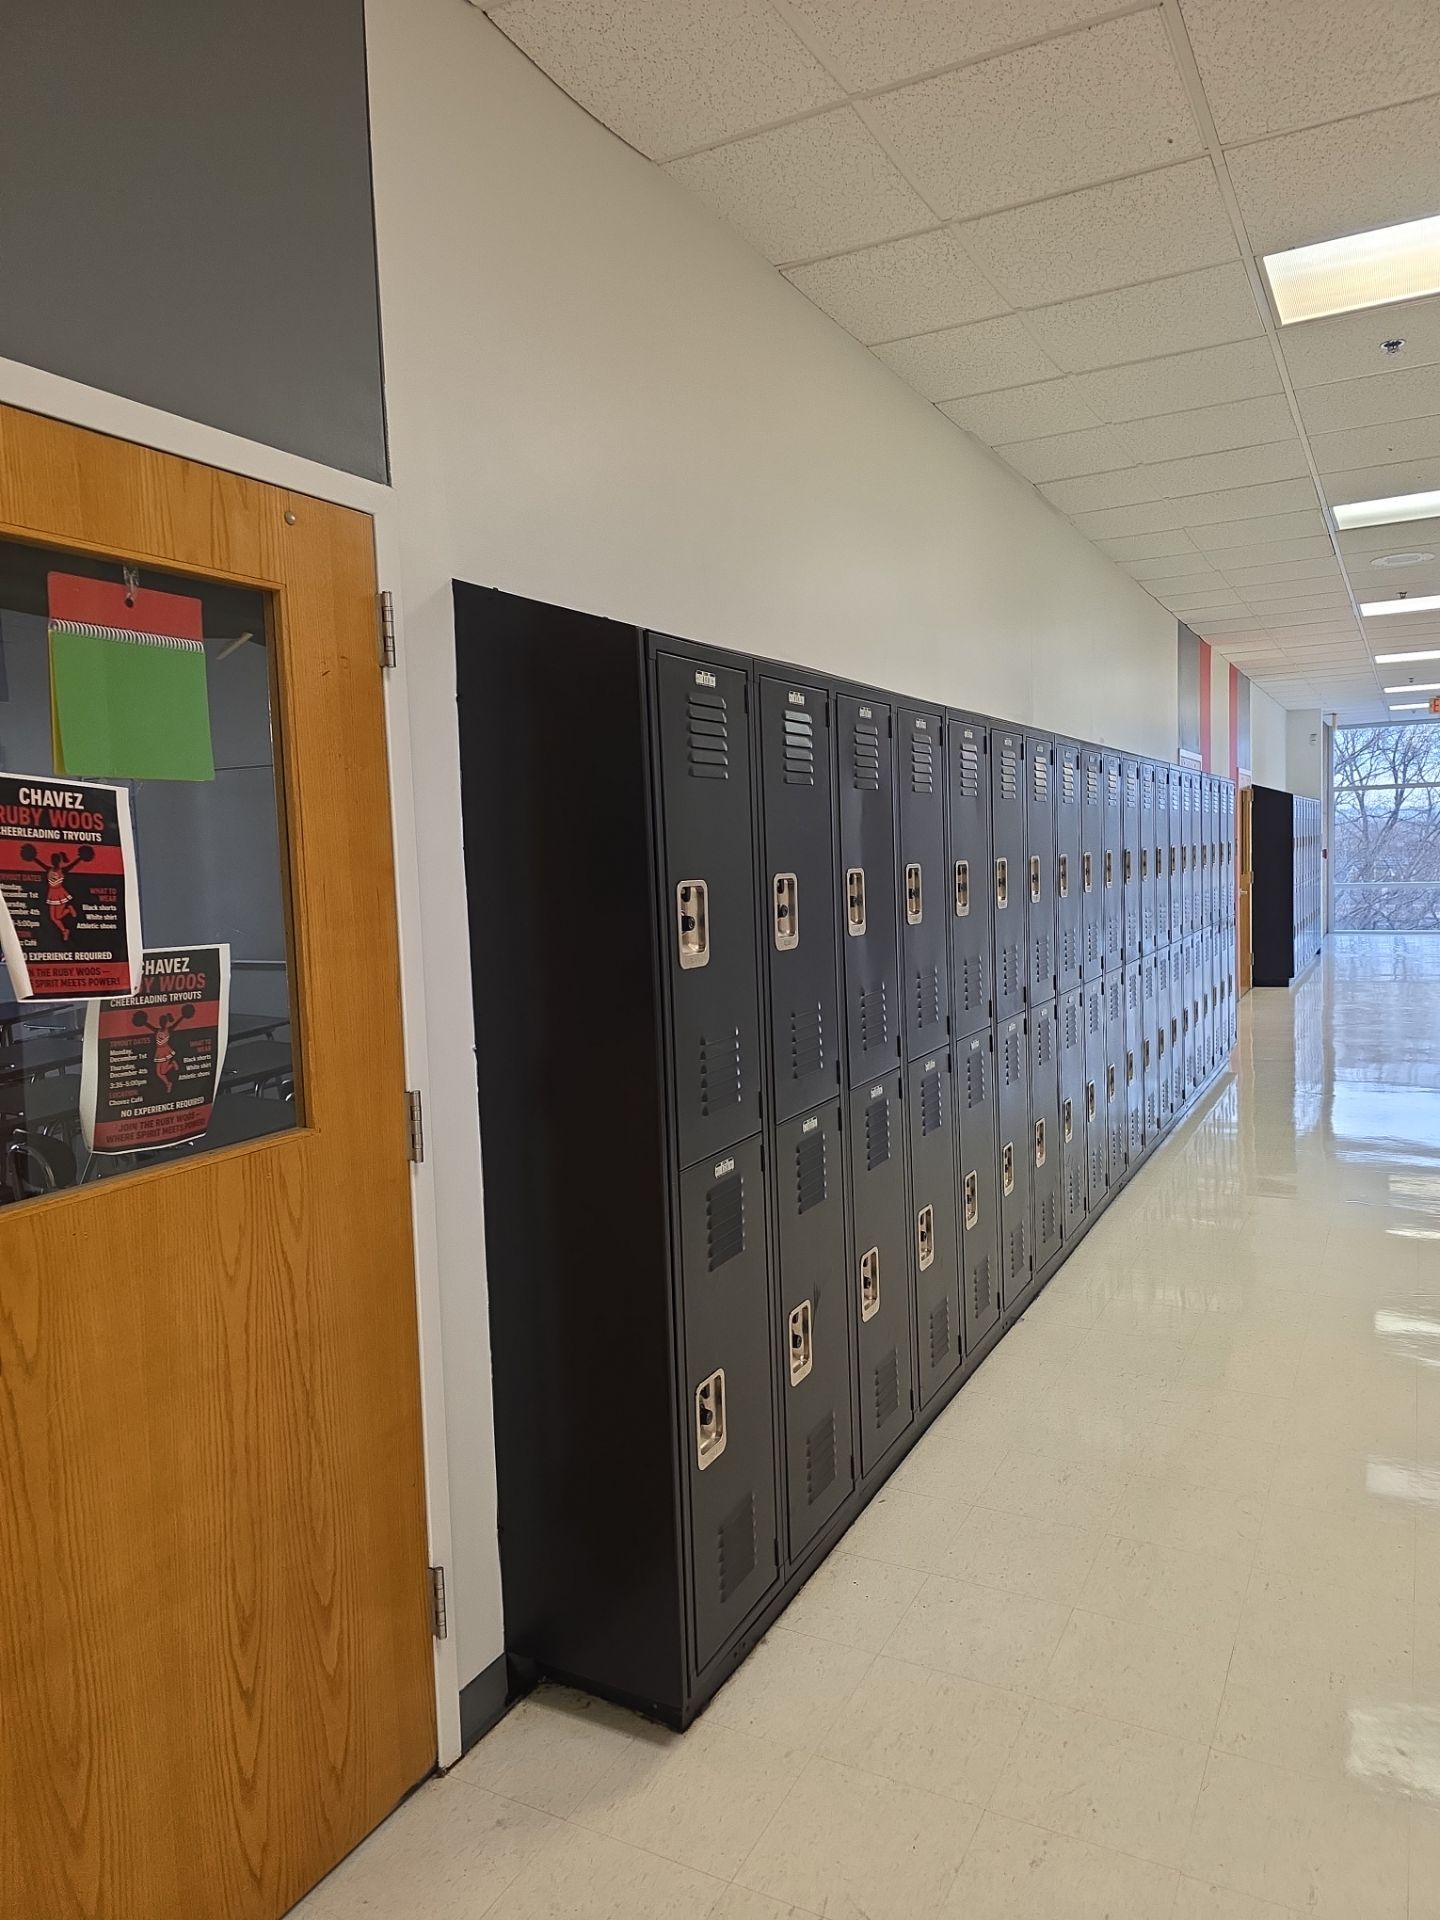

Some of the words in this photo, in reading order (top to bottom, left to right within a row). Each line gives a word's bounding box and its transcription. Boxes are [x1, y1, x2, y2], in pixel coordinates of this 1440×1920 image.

[19, 787, 84, 809] CHAVEZ
[48, 809, 105, 831] WOOS
[0, 826, 60, 840] HEERLEADING
[62, 830, 102, 842] TRYOUTS
[29, 952, 73, 960] EXPERIENCE
[74, 952, 112, 960] REQUIRED
[36, 968, 52, 977] THE
[53, 968, 74, 976] RUBY
[76, 968, 101, 976] WOOS
[60, 979, 87, 988] MEETS
[160, 973, 206, 992] WOOS
[110, 994, 168, 1007] CHEERLEADING
[169, 991, 202, 1002] TRYOUTS
[121, 1110, 132, 1118] NO
[134, 1102, 175, 1116] EXPERIENCE
[175, 1096, 205, 1109] REQUIRED
[118, 1122, 138, 1132] JOIN
[140, 1119, 154, 1129] THE
[155, 1117, 175, 1127] RUBY
[106, 1132, 134, 1143] WHERE
[135, 1128, 161, 1139] SPIRIT
